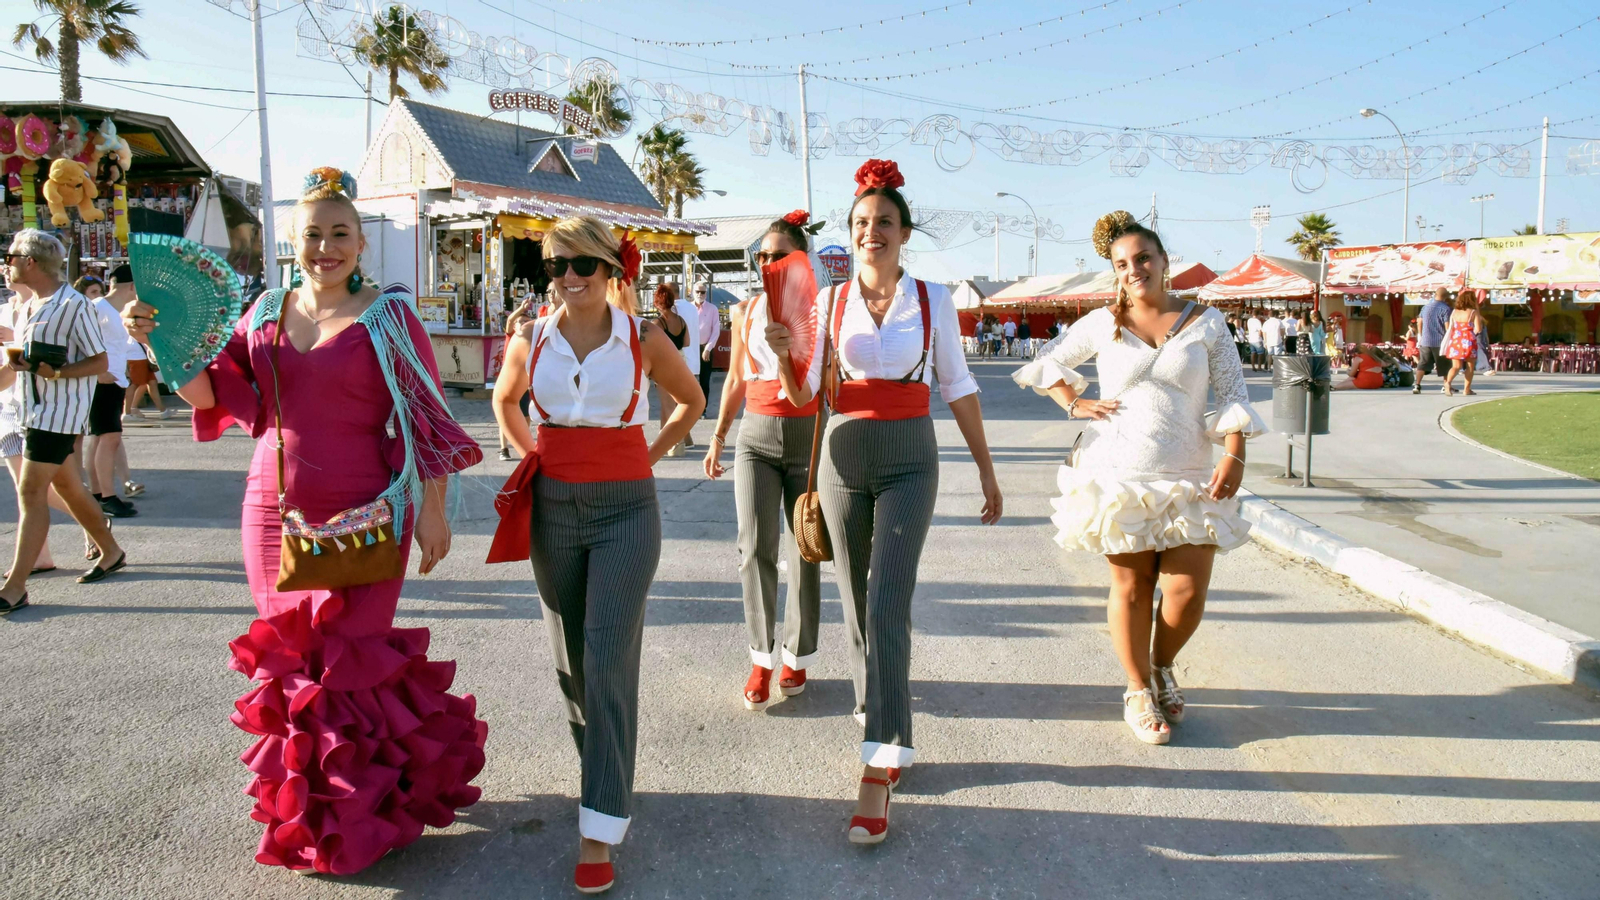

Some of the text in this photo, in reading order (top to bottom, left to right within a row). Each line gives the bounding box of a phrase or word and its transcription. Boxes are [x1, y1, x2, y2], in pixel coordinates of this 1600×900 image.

[490, 91, 592, 131] GOFRES EMI
[573, 147, 593, 155] GOFRES
[520, 203, 544, 212] GOFRES
